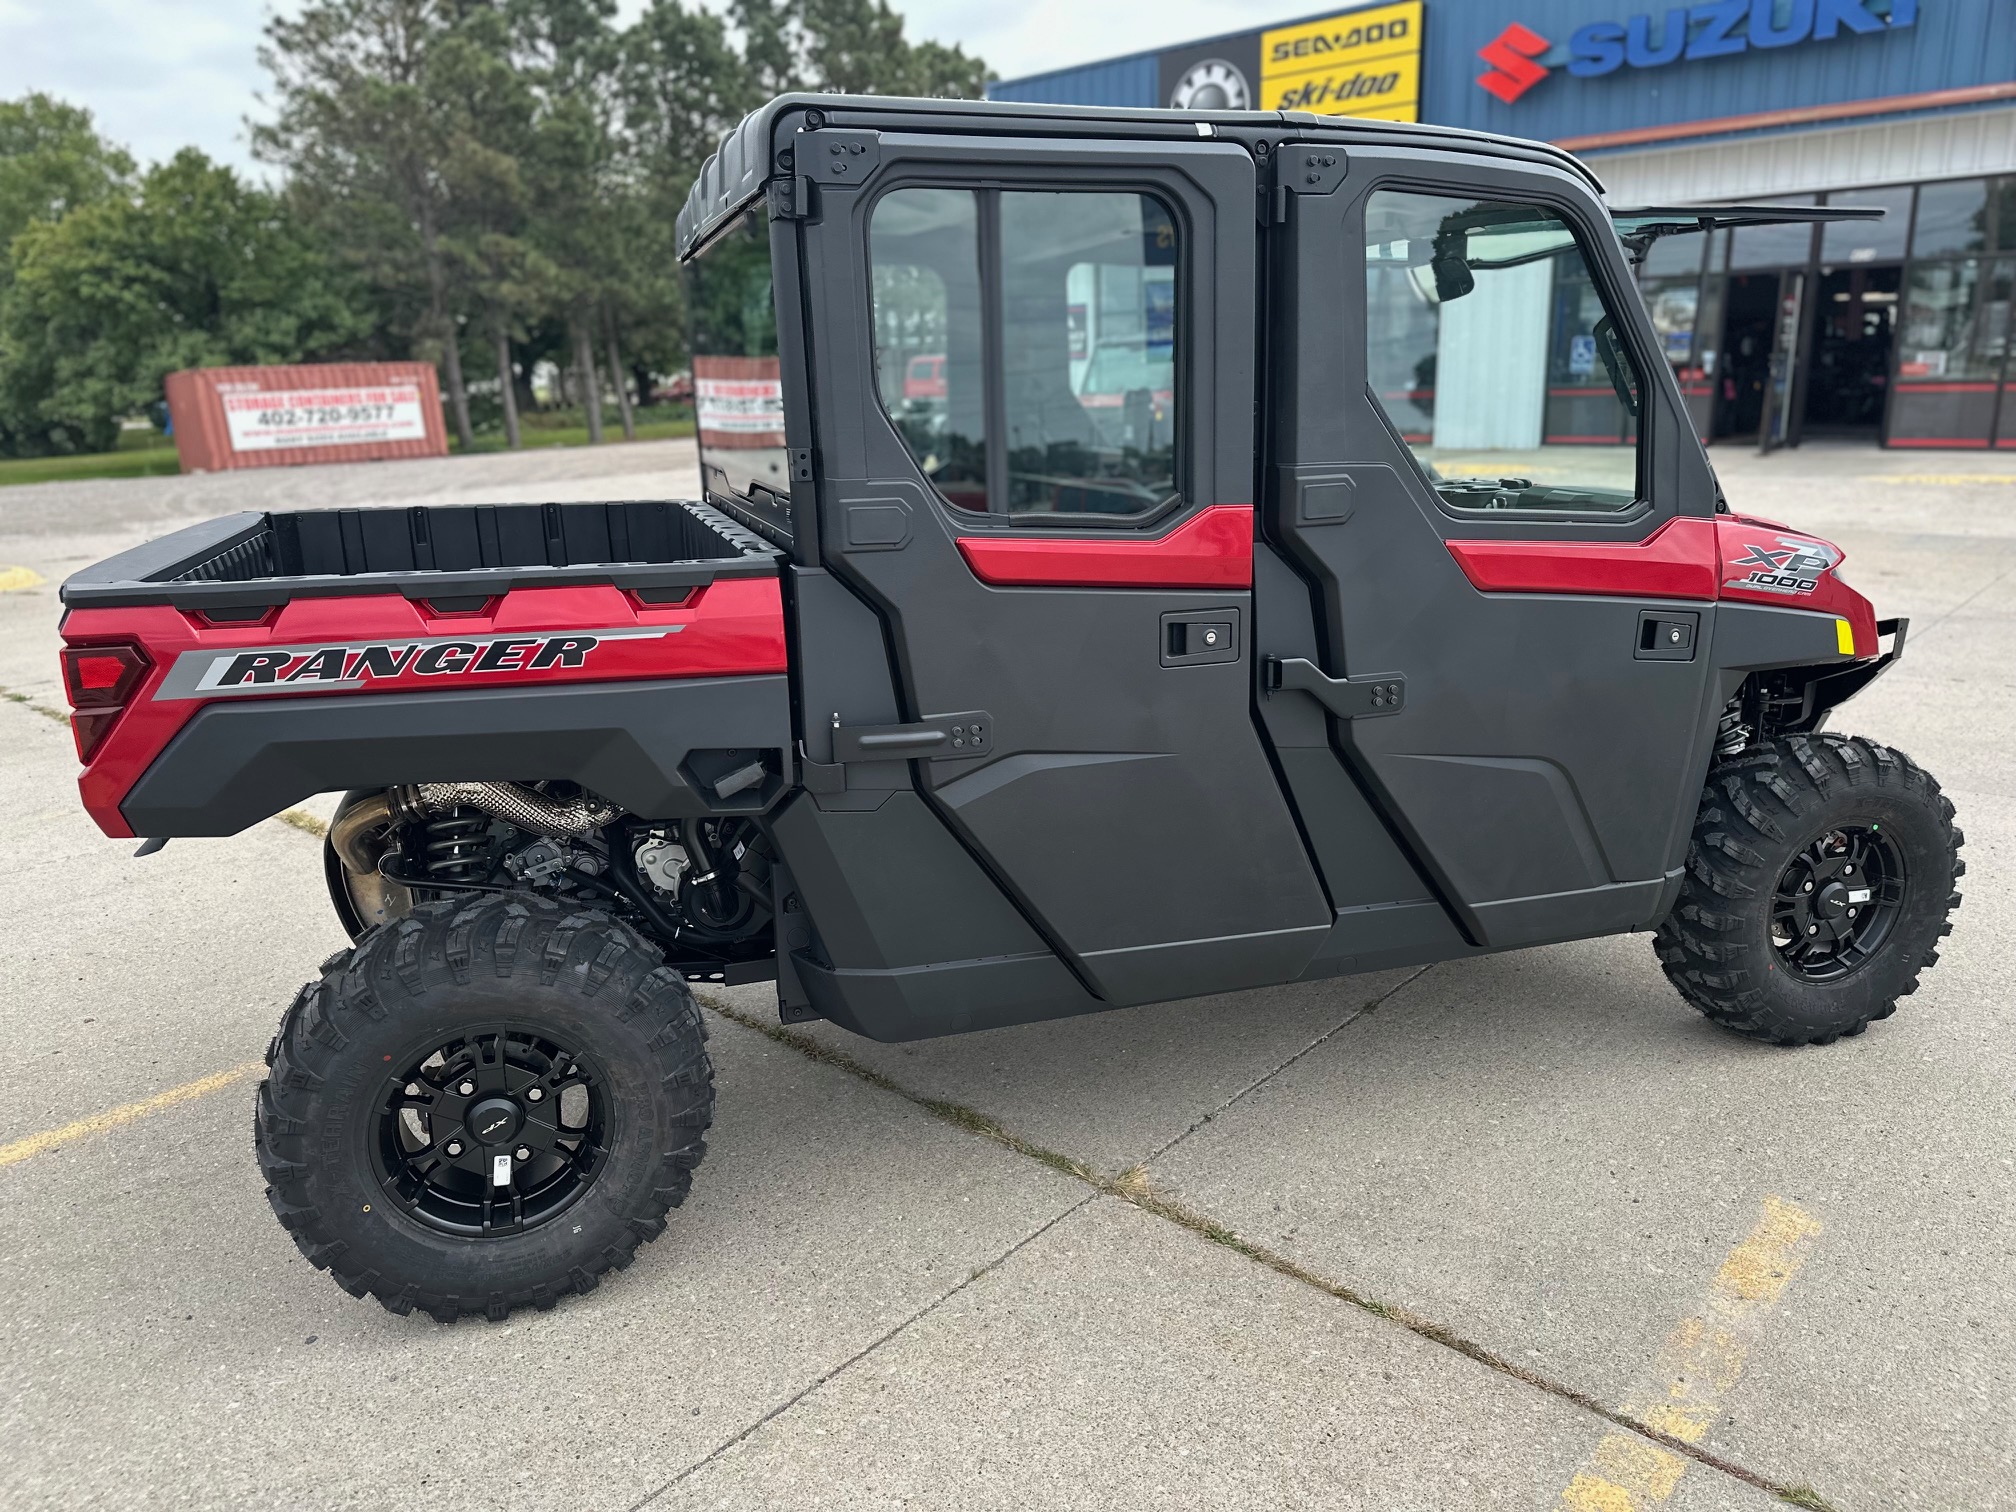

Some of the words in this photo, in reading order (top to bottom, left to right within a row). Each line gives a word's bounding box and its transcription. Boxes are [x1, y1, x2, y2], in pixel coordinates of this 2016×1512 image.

[257, 403, 395, 428] 402-720-9577
[1728, 544, 1831, 571] XP
[1748, 571, 1818, 592] 1000
[214, 636, 601, 687] RANGER
